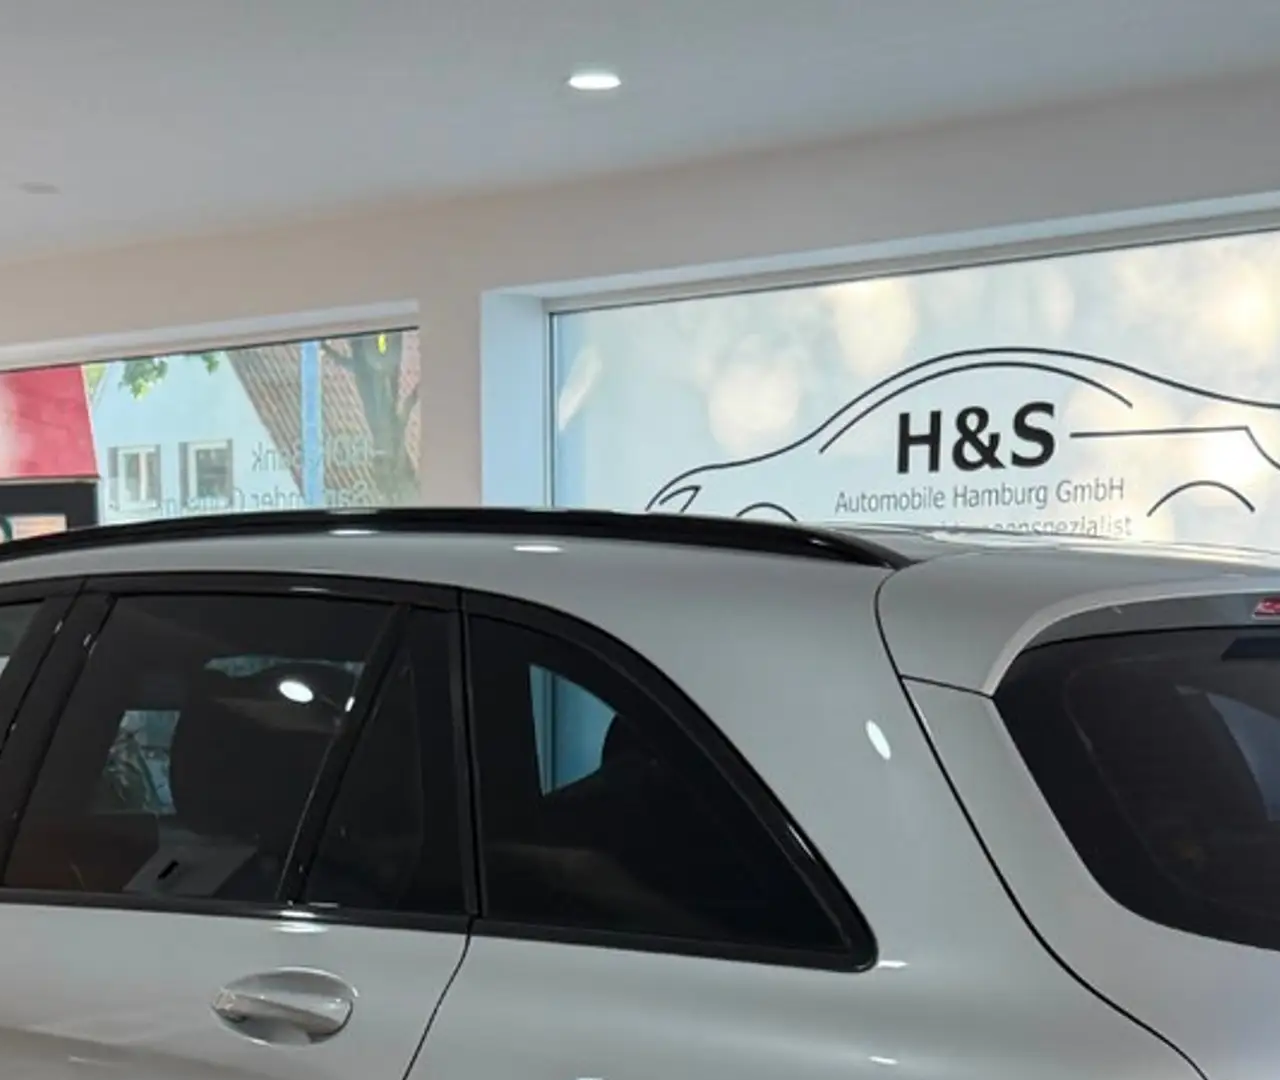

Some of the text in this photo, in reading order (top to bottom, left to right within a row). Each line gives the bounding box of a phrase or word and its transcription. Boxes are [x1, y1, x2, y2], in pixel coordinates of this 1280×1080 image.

[897, 401, 1056, 474] H&S
[834, 477, 1125, 514] Automobile Hamburg GmbH
